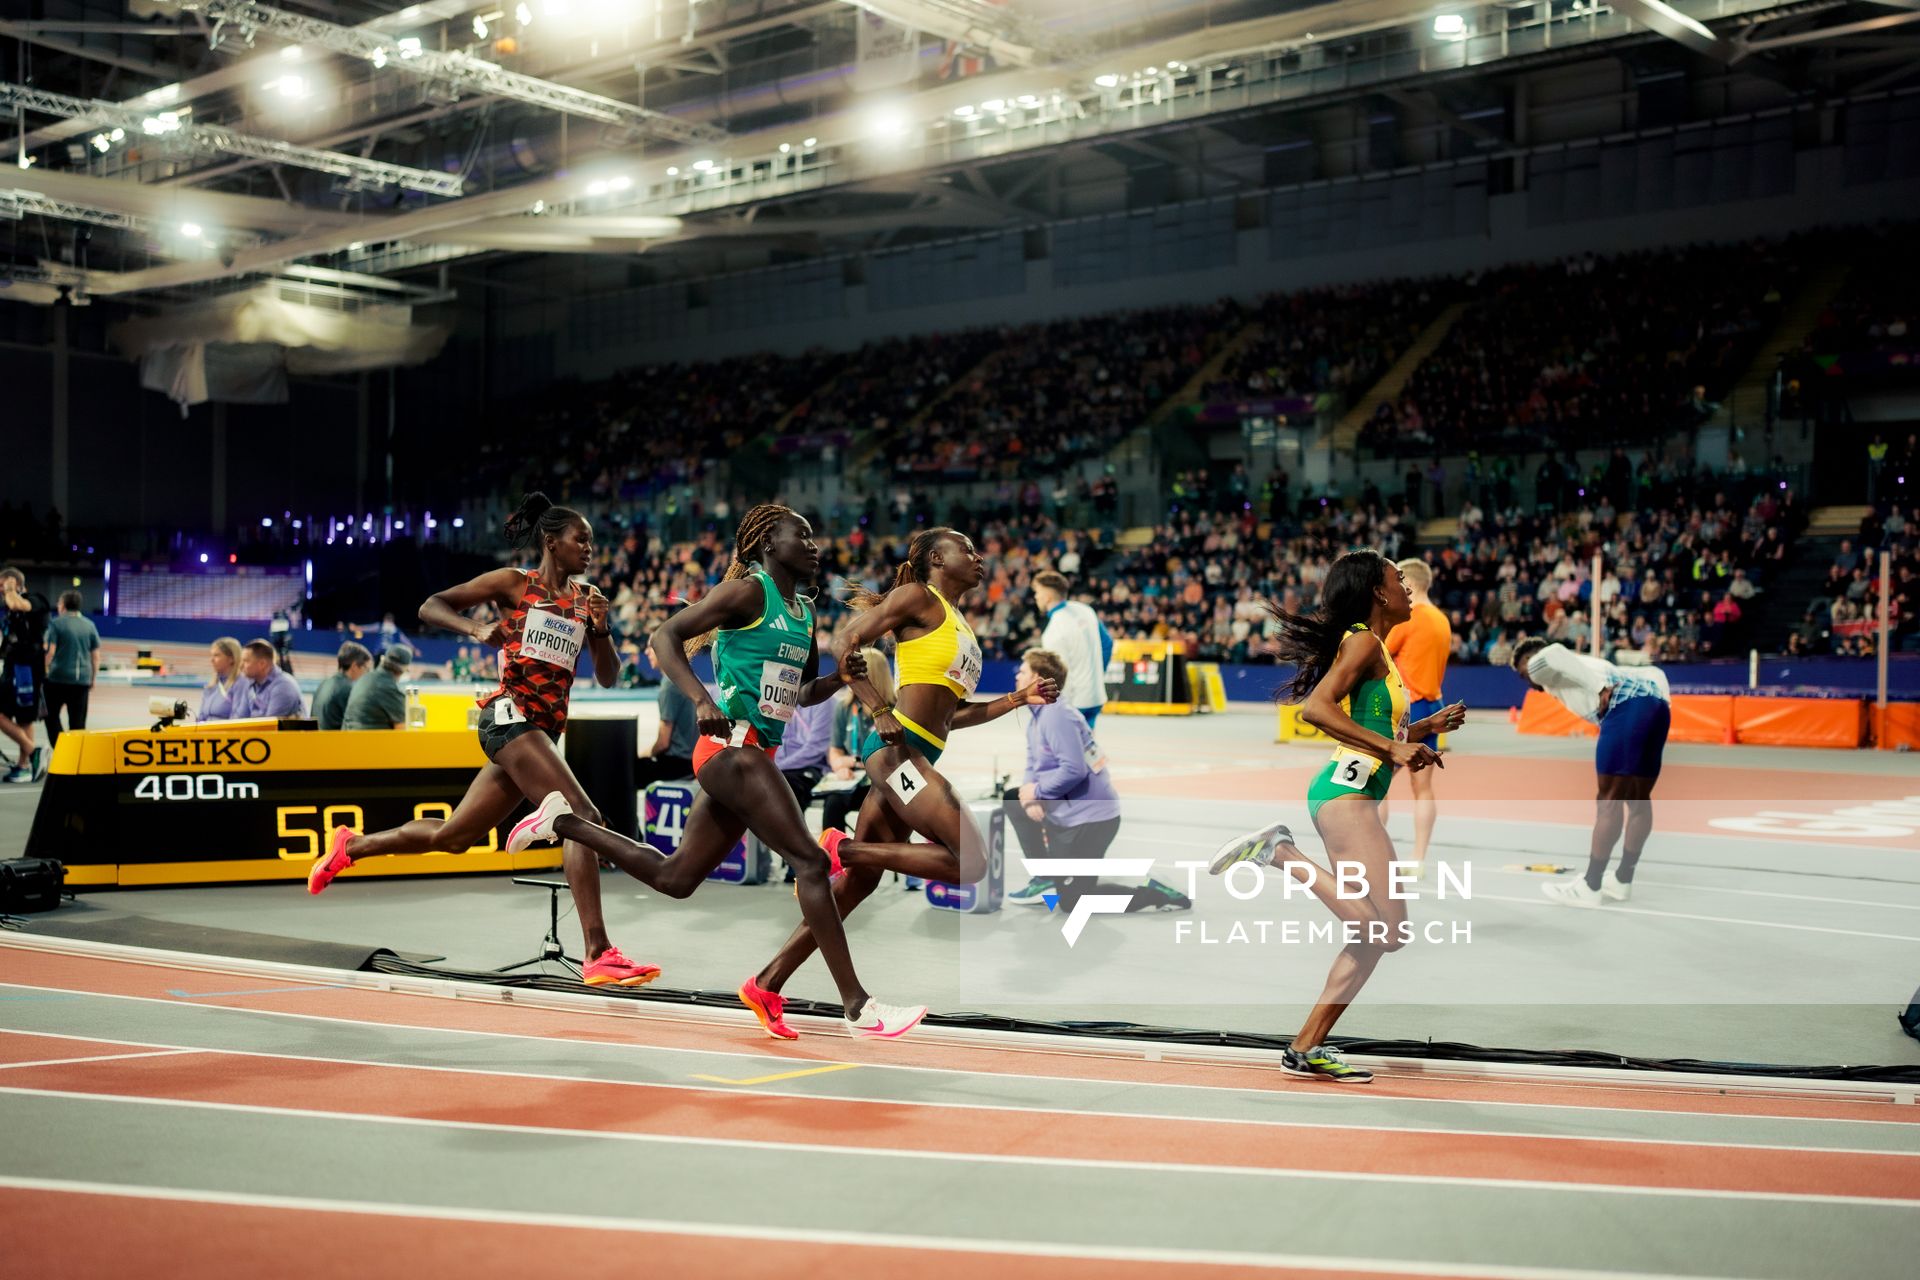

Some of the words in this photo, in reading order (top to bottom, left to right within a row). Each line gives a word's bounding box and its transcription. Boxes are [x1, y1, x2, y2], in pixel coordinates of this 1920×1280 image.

[526, 628, 580, 657] KIPROTICH
[123, 738, 271, 766] SEIKO
[900, 771, 916, 792] 4
[1342, 760, 1360, 782] 6
[134, 774, 259, 800] 400m
[656, 803, 684, 848] 4
